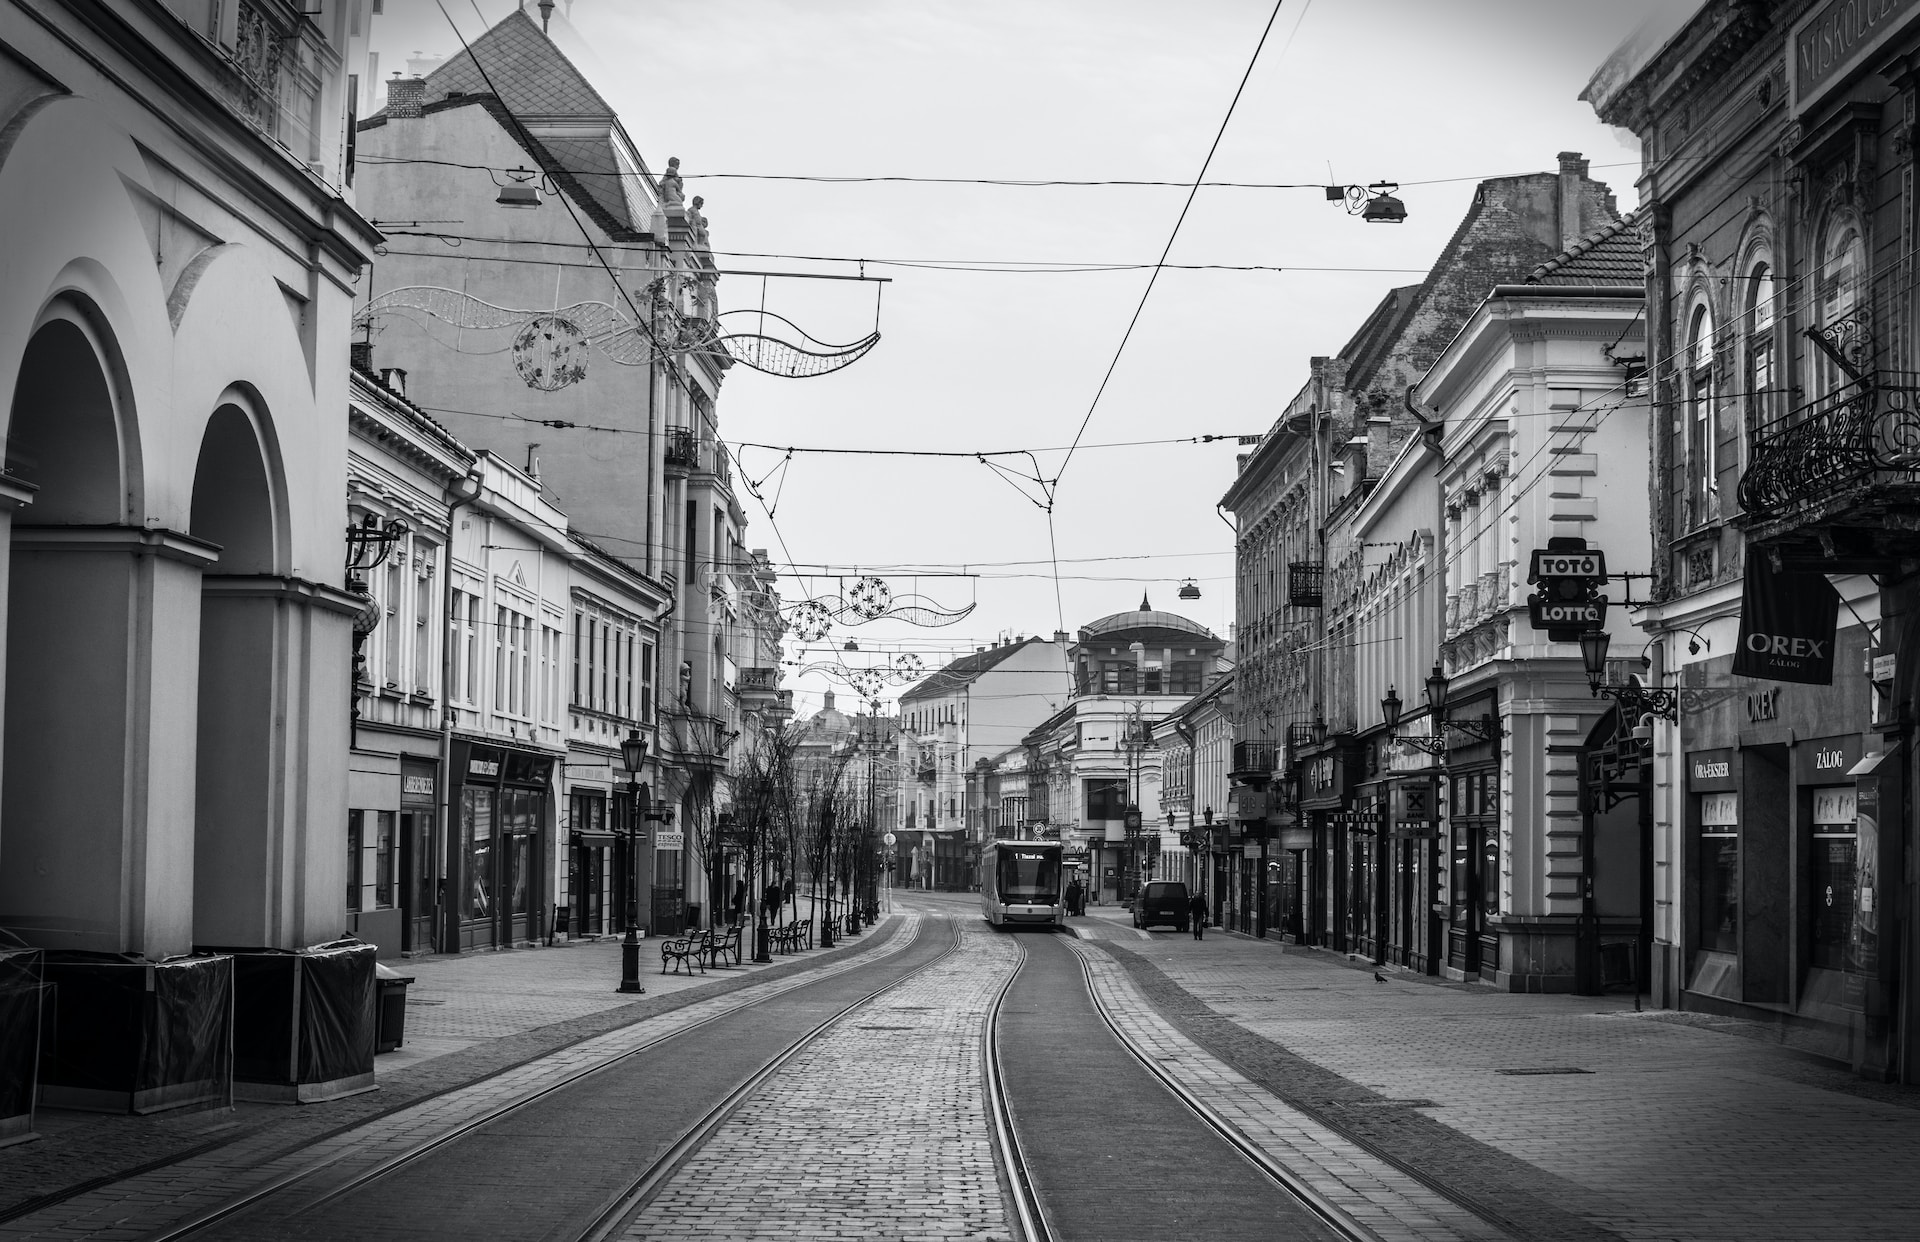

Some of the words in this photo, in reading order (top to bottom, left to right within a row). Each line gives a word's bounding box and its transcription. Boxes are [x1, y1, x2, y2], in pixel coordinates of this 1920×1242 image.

[1746, 633, 1824, 659] OREX
[1769, 658, 1800, 669] ZÁLOG
[1816, 747, 1843, 769] ZÁLOG
[1695, 760, 1730, 778] ÓRA-ÉKSZER
